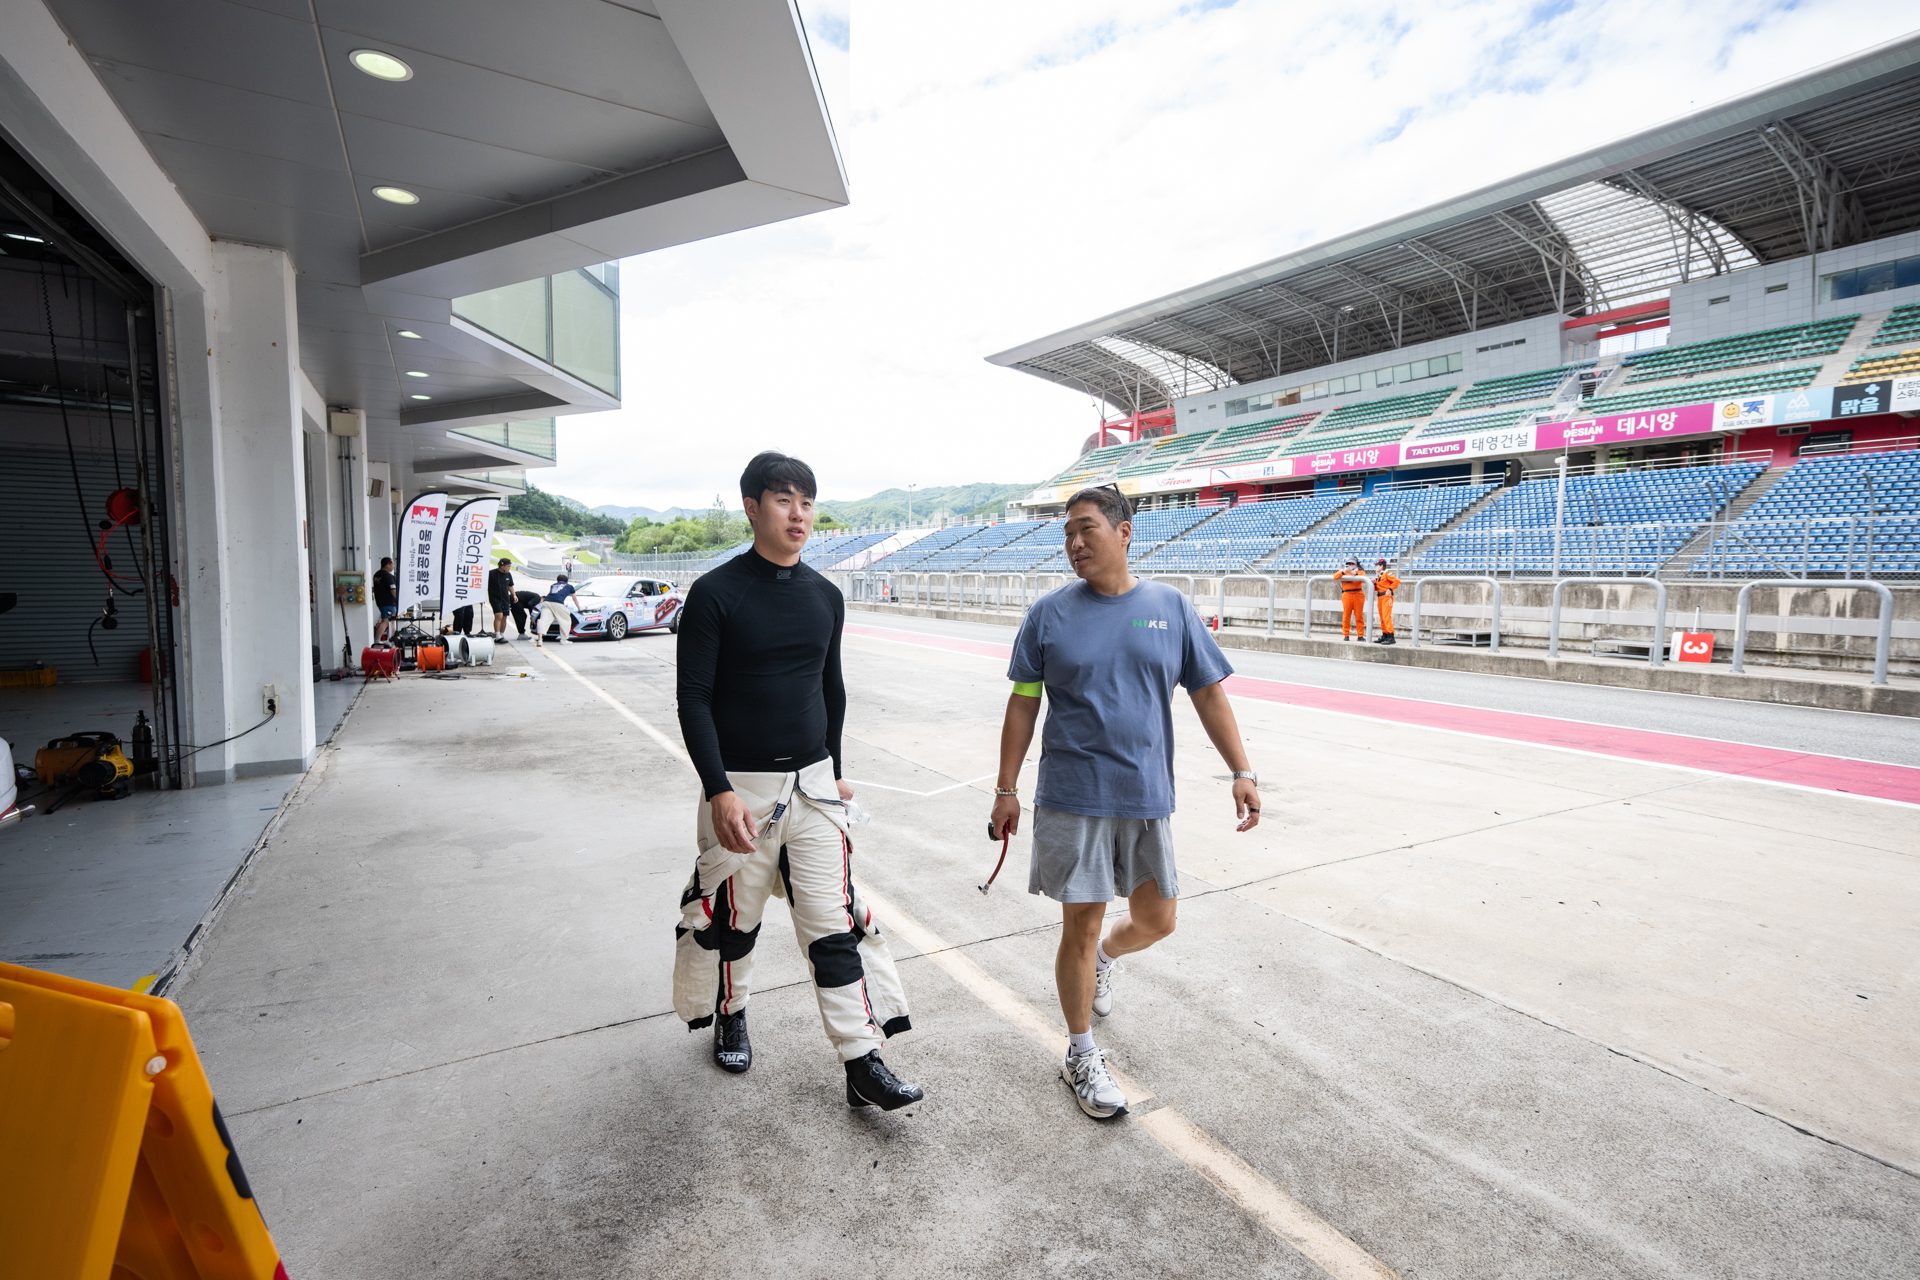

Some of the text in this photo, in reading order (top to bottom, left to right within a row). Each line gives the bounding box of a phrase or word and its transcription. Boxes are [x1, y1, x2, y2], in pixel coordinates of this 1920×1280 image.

[1840, 396, 1880, 415] 맑음
[1563, 411, 1679, 438] DESIAN 데시앙
[1411, 432, 1529, 456] TAEYOUNG 태영건설
[1343, 449, 1380, 466] 데시앙
[465, 513, 490, 564] LeTech
[415, 529, 432, 596] 동일윤활유
[455, 564, 470, 600] 코리아
[1683, 641, 1709, 654] 3
